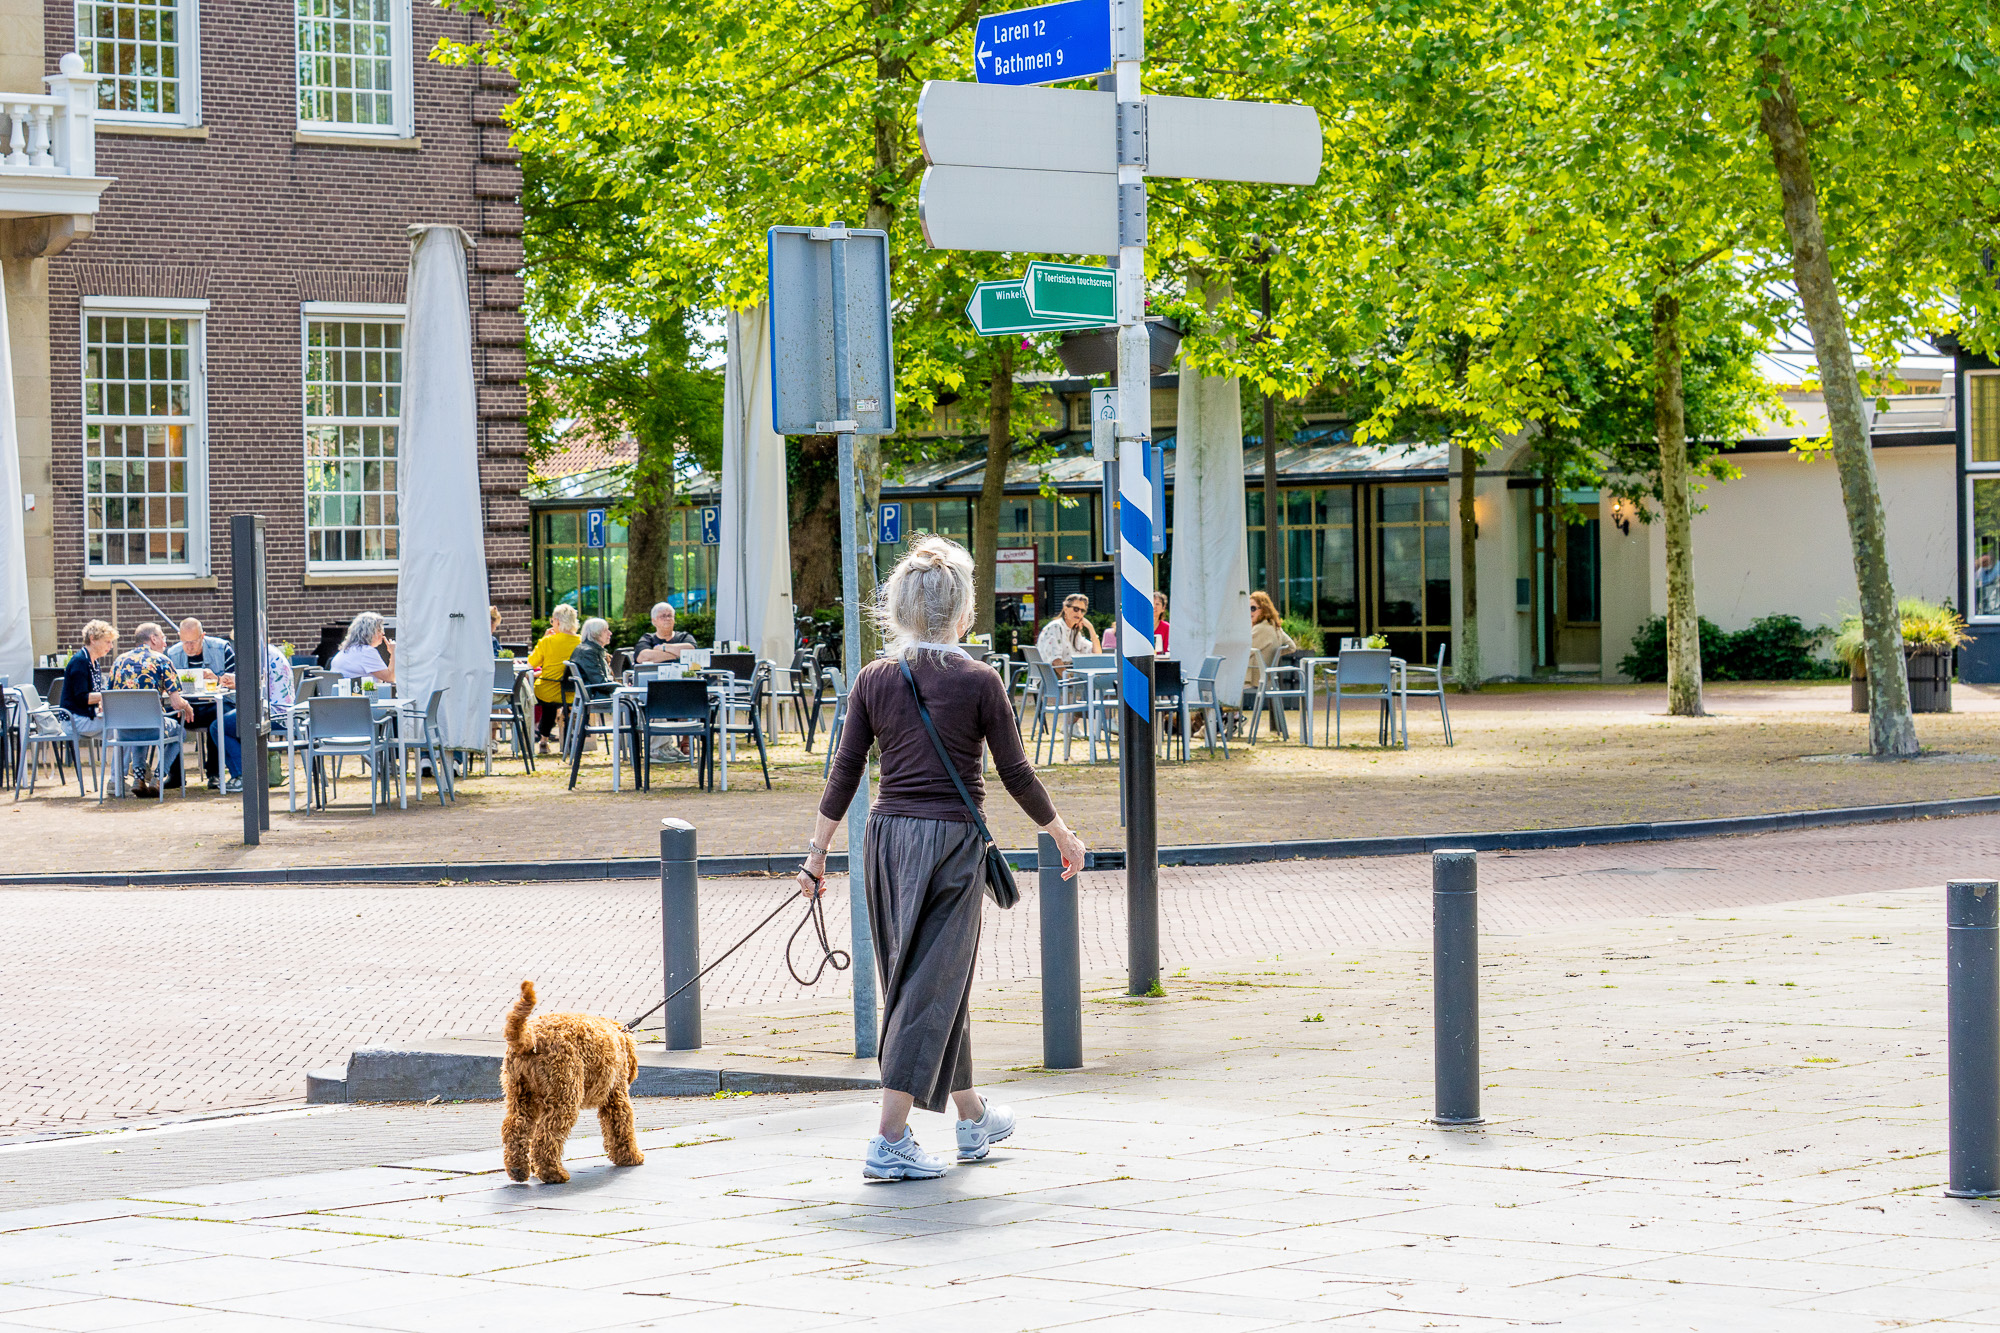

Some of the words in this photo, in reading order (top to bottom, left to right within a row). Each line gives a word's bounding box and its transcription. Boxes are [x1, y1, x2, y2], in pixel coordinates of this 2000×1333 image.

[994, 23, 1029, 44] Laren
[1033, 19, 1046, 36] 12
[995, 52, 1052, 76] Bathmen
[1056, 48, 1064, 66] 9
[1044, 272, 1076, 284] Toeristisch
[1077, 276, 1112, 288] touchscreen
[1103, 410, 1113, 420] 34
[591, 513, 601, 532] P
[704, 509, 716, 529] P
[884, 507, 896, 527] P
[879, 1145, 917, 1163] SALOMON
